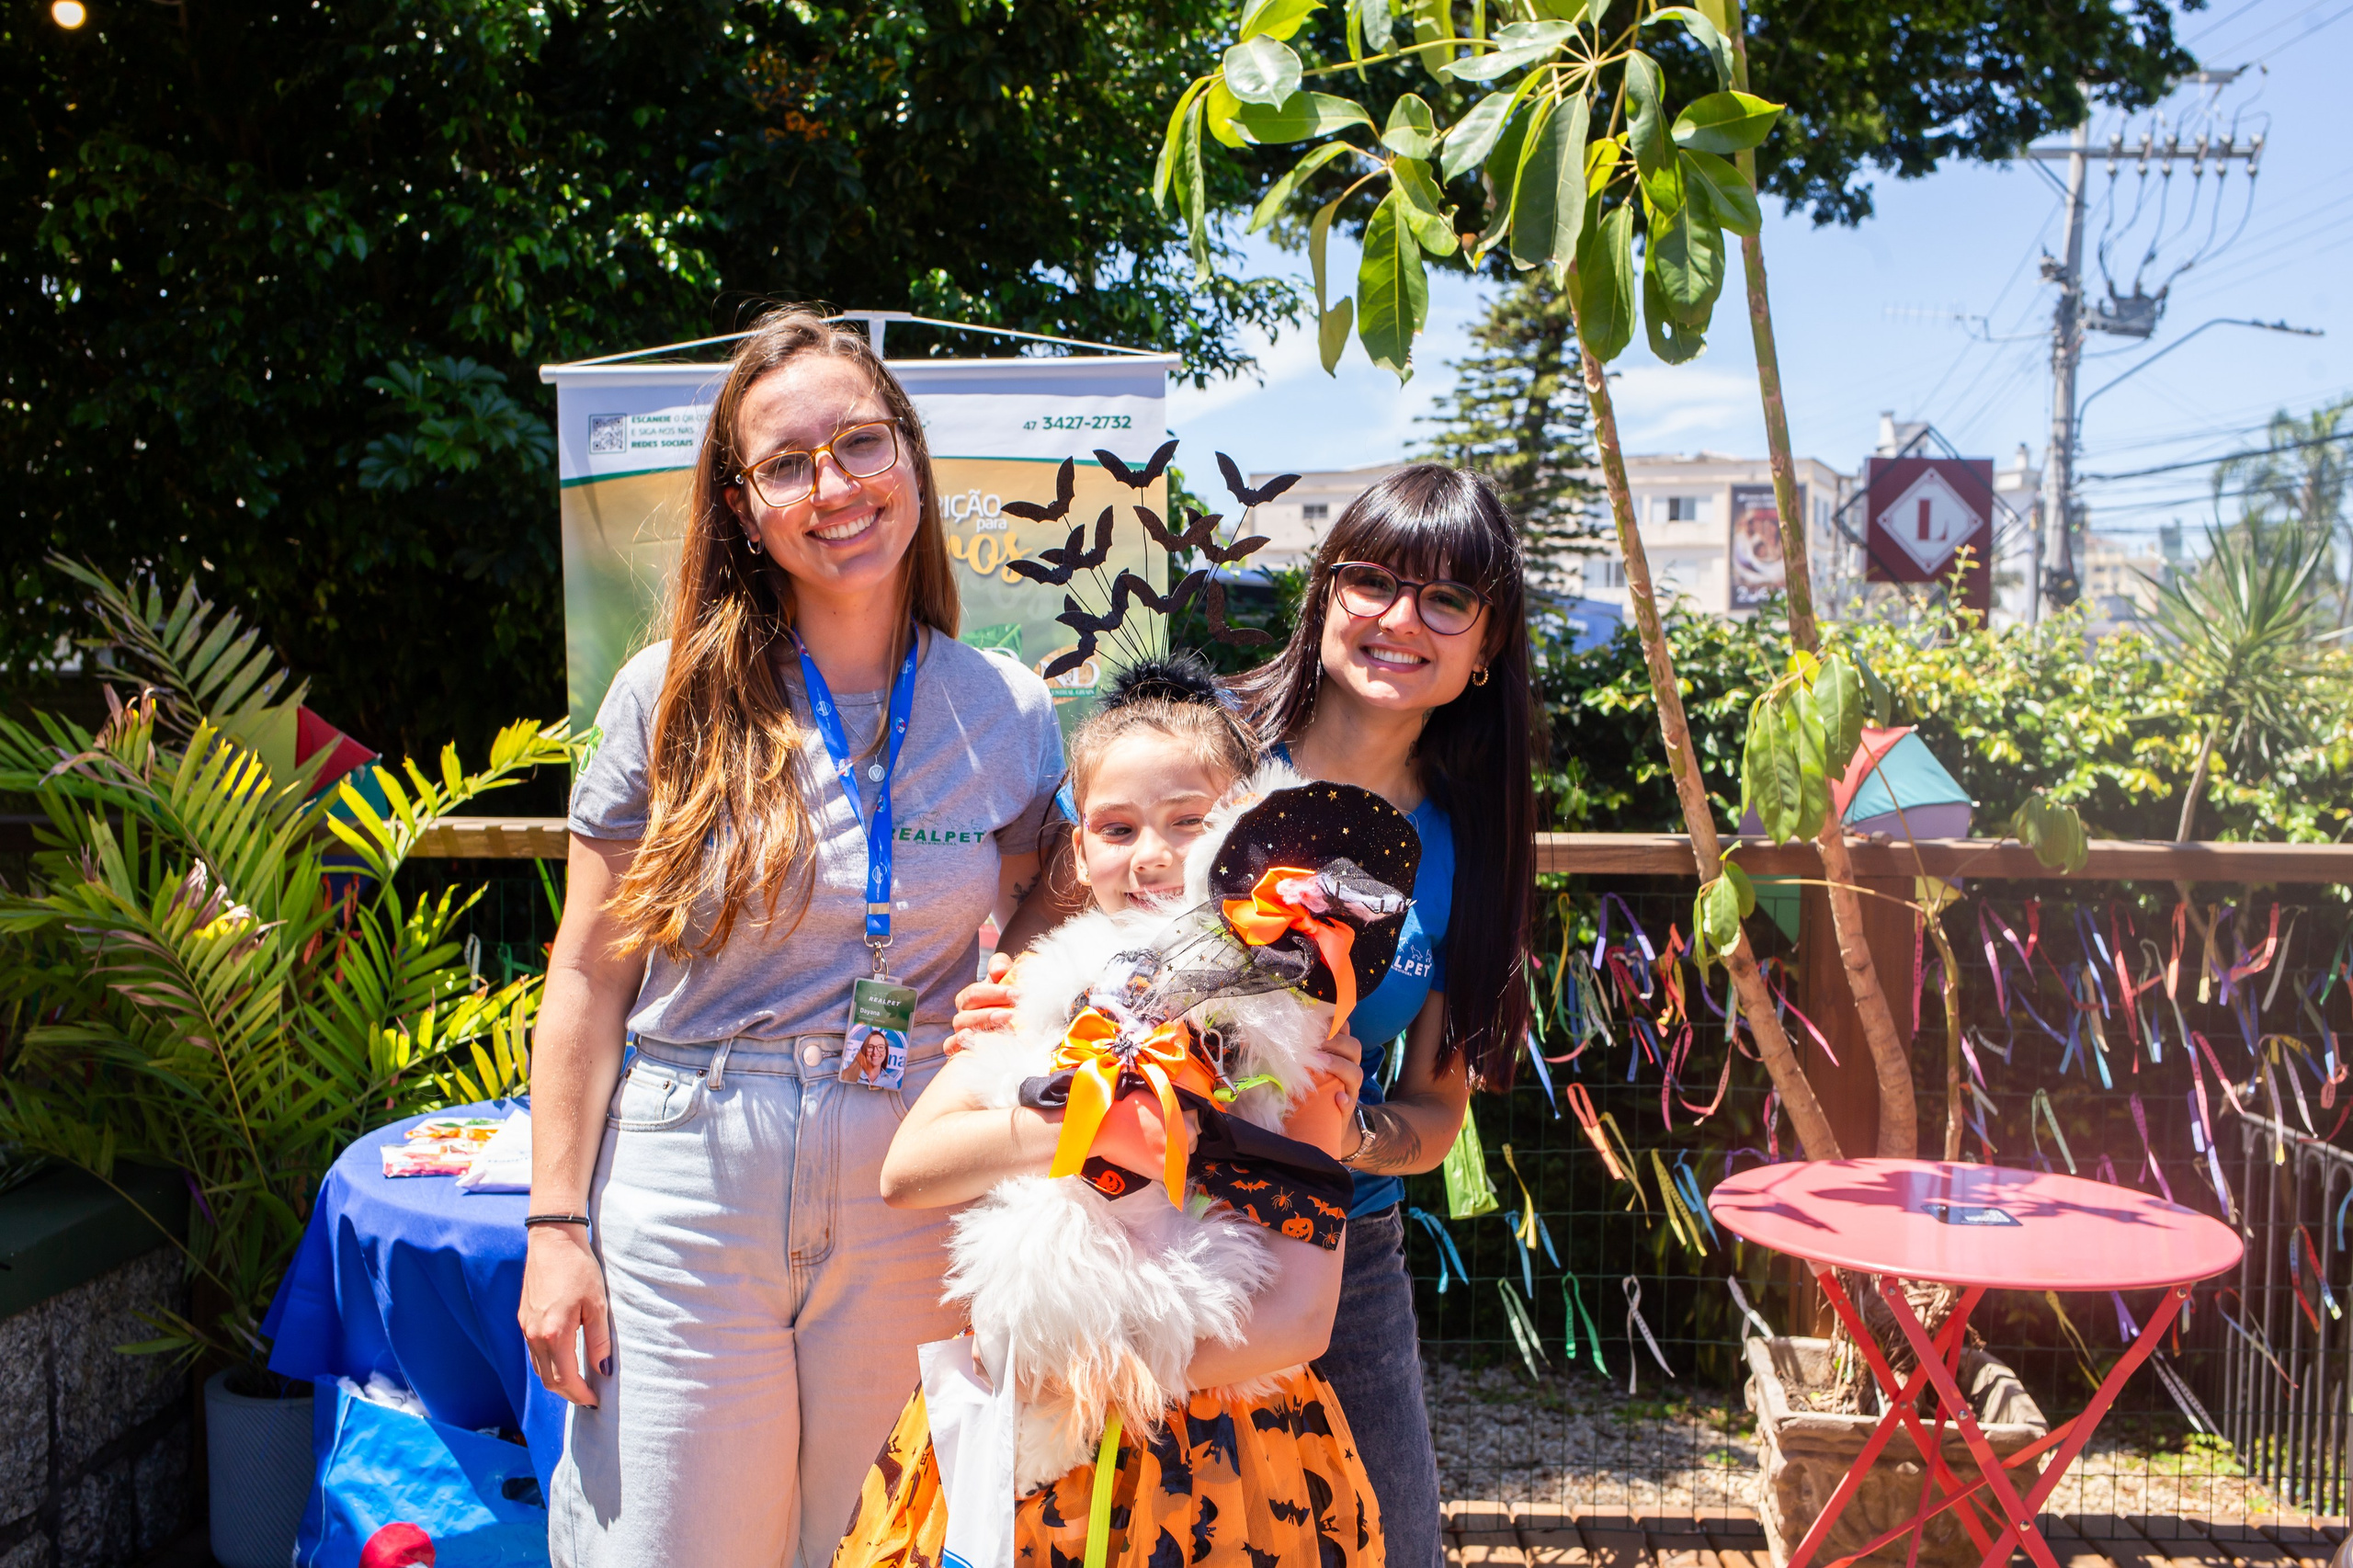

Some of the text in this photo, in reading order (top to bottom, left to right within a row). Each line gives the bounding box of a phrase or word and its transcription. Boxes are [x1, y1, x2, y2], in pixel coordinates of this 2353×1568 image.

[1023, 415, 1131, 430] 47 3427-2732
[661, 439, 693, 448] SOCIAIS
[938, 489, 1002, 524] IÇÃO
[976, 518, 1008, 533] para
[1917, 499, 1949, 540] L
[869, 996, 901, 1006] REALPET
[859, 1007, 881, 1017] Dayana
